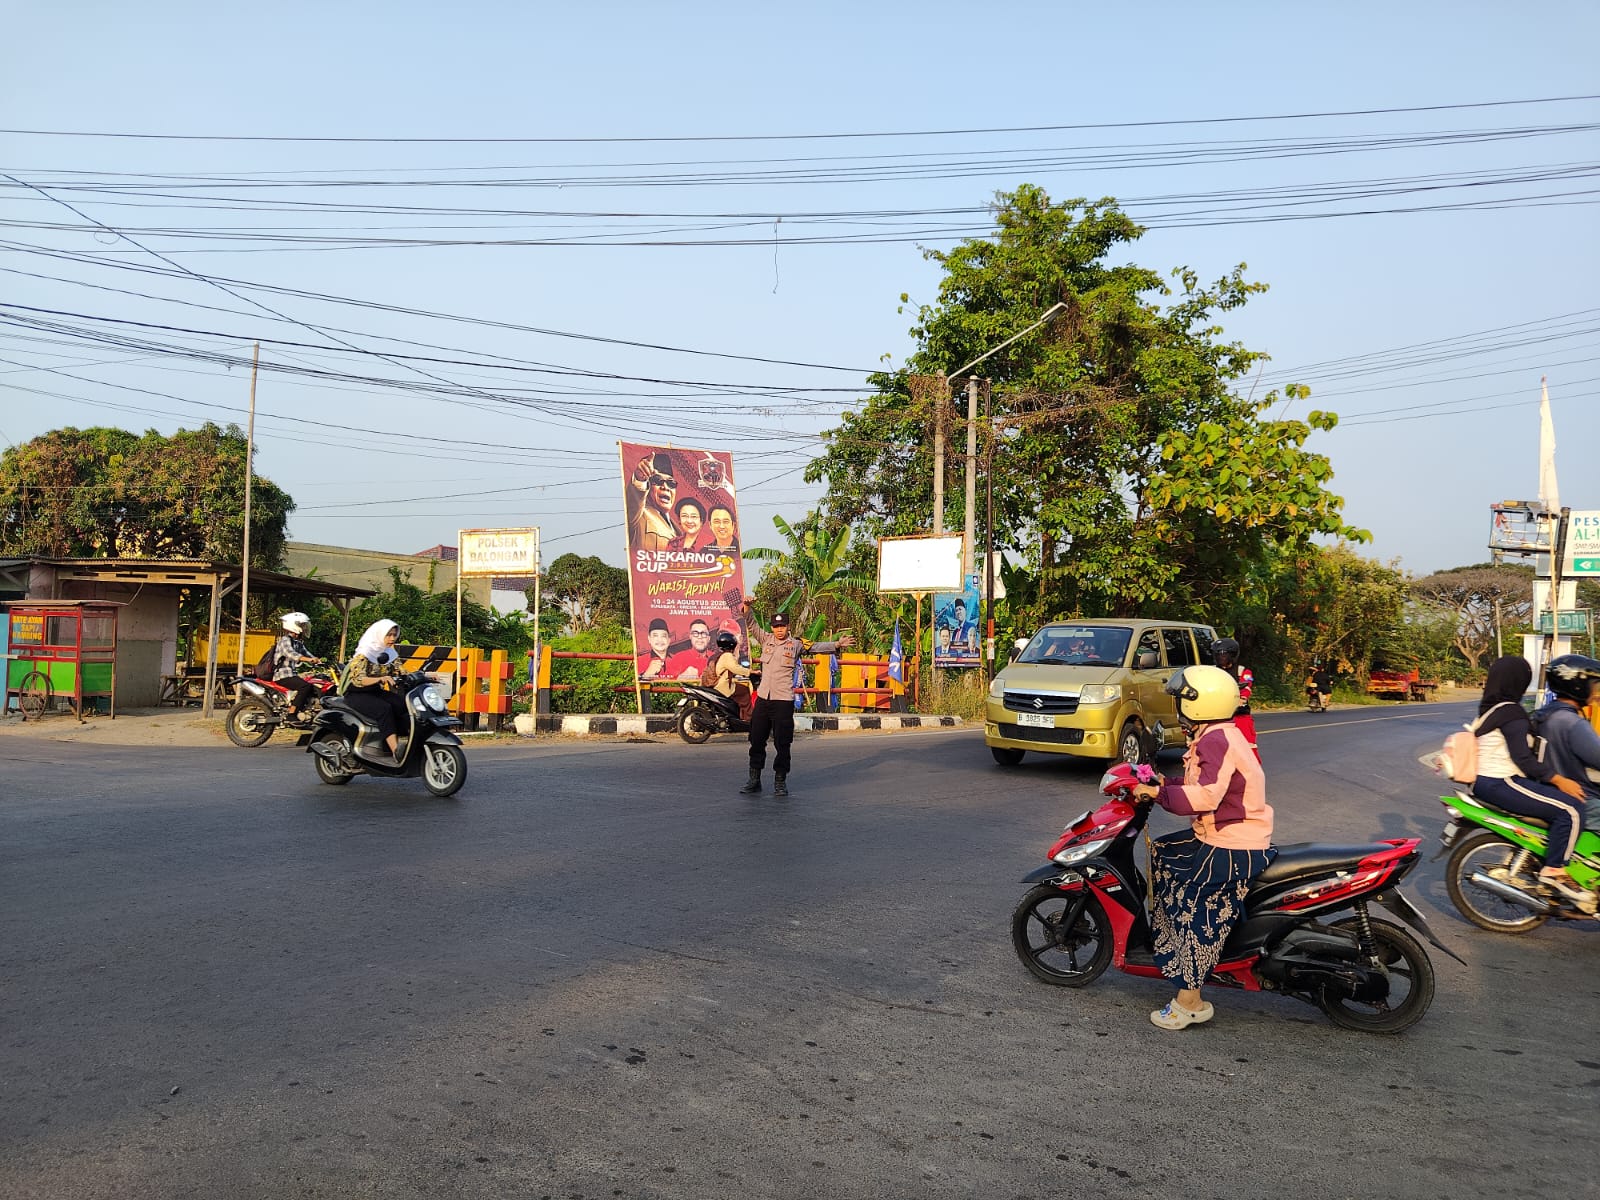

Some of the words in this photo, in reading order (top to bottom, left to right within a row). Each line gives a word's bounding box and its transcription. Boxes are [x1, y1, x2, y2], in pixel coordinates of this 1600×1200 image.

[478, 537, 518, 548] POLSEK
[470, 551, 527, 562] BALONGAN
[636, 550, 715, 564] SOEKARNO
[636, 561, 668, 573] CUP
[648, 579, 688, 596] WARISI
[685, 577, 726, 599] APINYA!
